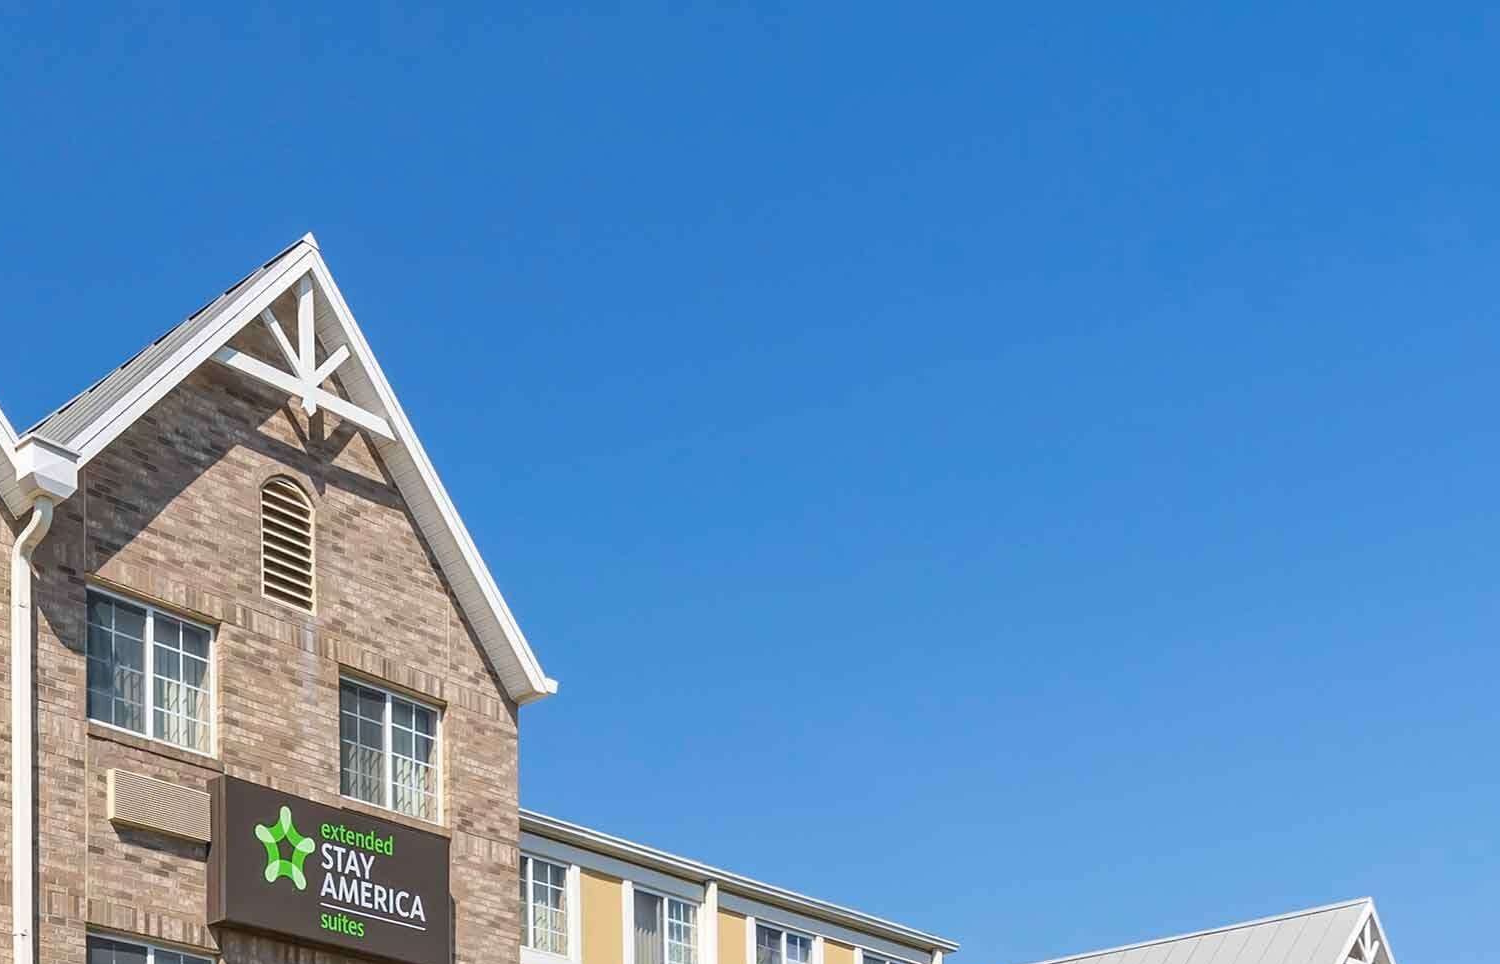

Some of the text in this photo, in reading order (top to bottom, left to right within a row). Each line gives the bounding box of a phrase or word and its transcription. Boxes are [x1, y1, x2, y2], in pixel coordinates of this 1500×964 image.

[321, 823, 393, 856] extended
[321, 842, 375, 880] STAY
[320, 872, 426, 922] AMERICA
[321, 913, 365, 937] suites
